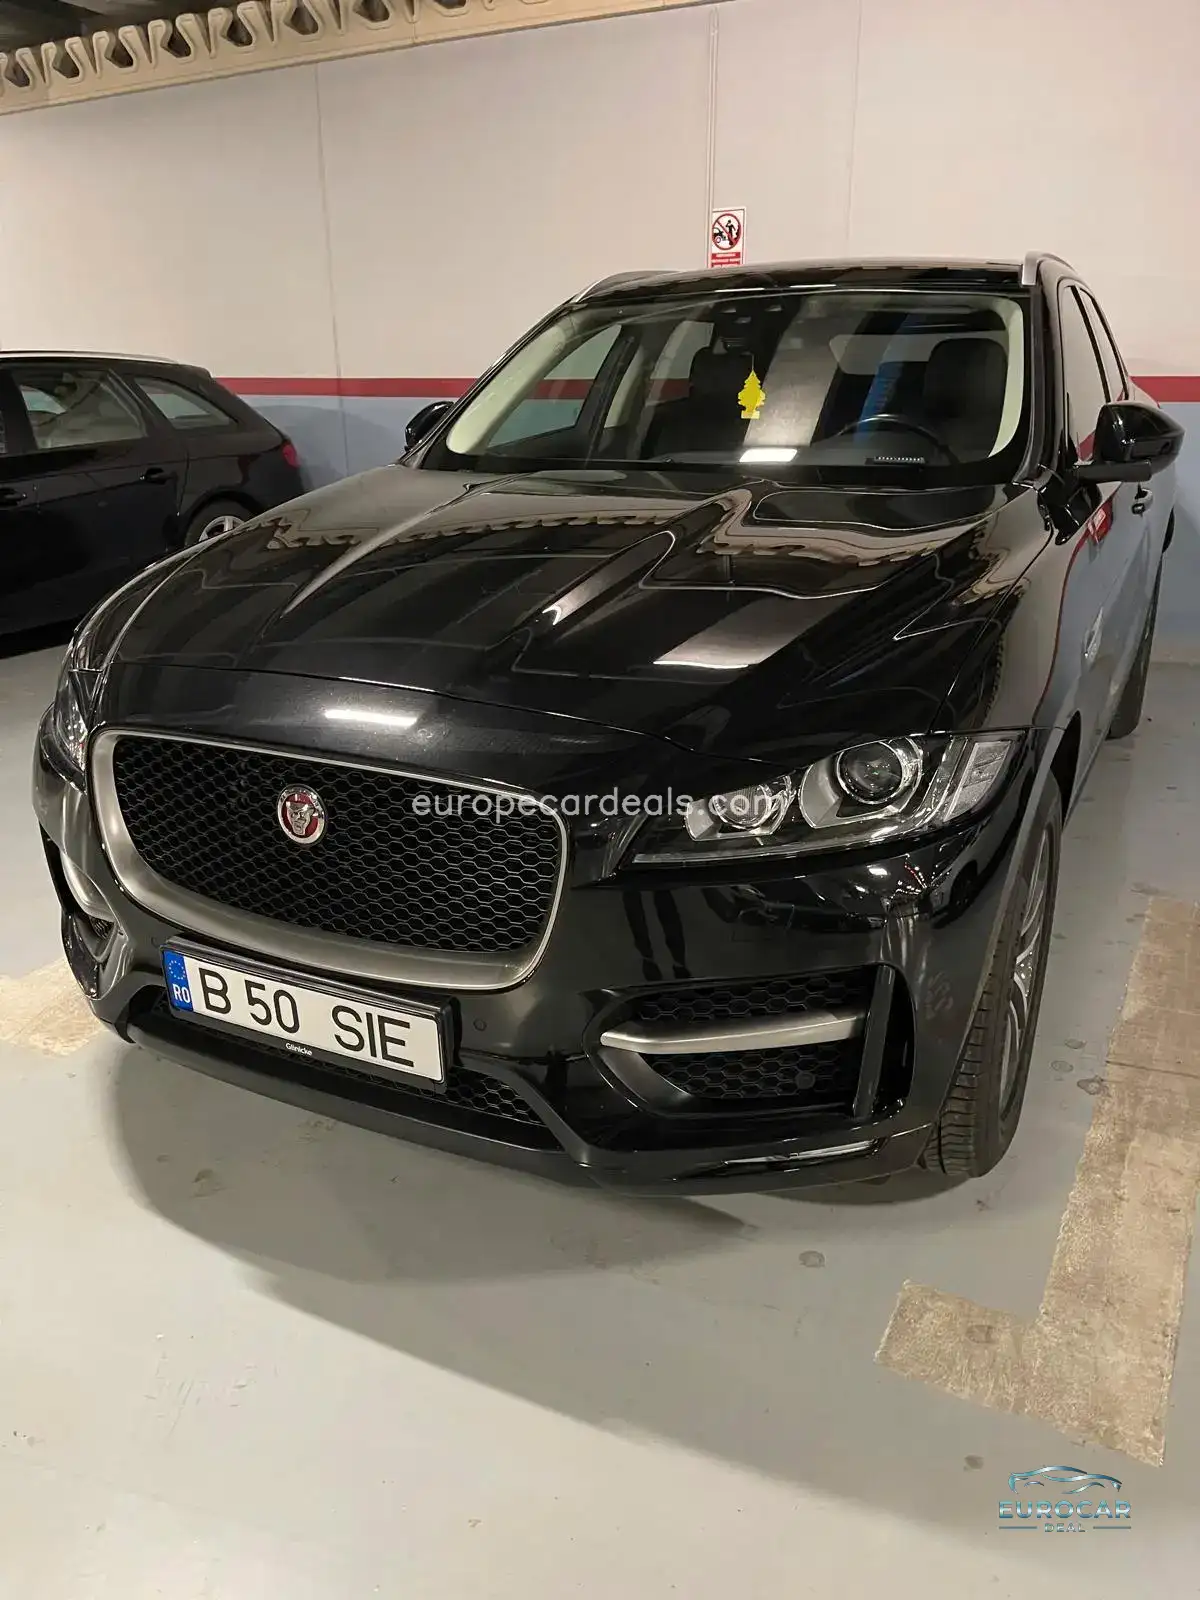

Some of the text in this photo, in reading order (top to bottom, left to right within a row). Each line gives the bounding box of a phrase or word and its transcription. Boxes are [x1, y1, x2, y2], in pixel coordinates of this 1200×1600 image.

[172, 983, 191, 1004] RO
[198, 967, 414, 1068] B 50 SIE
